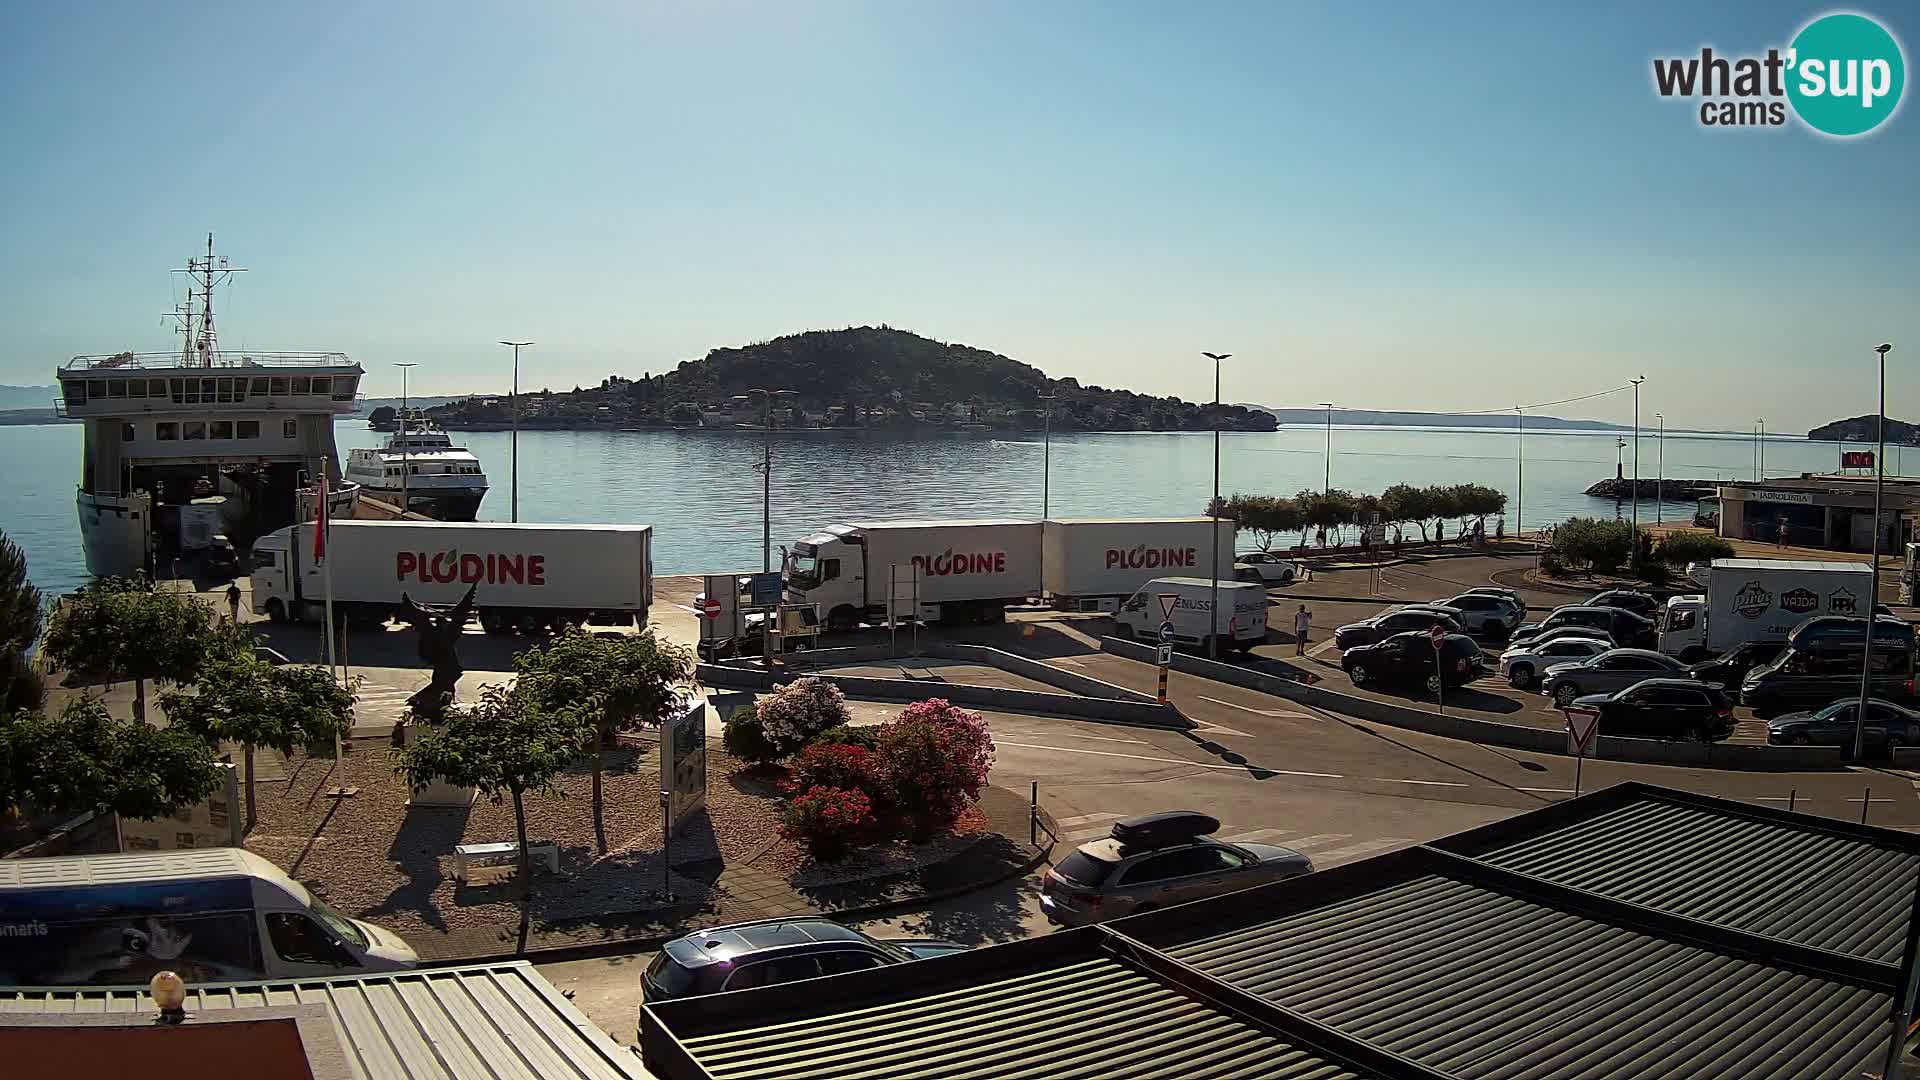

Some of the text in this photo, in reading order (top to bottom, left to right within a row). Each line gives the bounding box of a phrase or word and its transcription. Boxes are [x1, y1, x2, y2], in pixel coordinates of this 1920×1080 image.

[397, 551, 545, 585] PLODINE
[911, 549, 1005, 576] PLODINE
[1106, 547, 1196, 569] PLODINE
[1783, 597, 1816, 608] VAJDA
